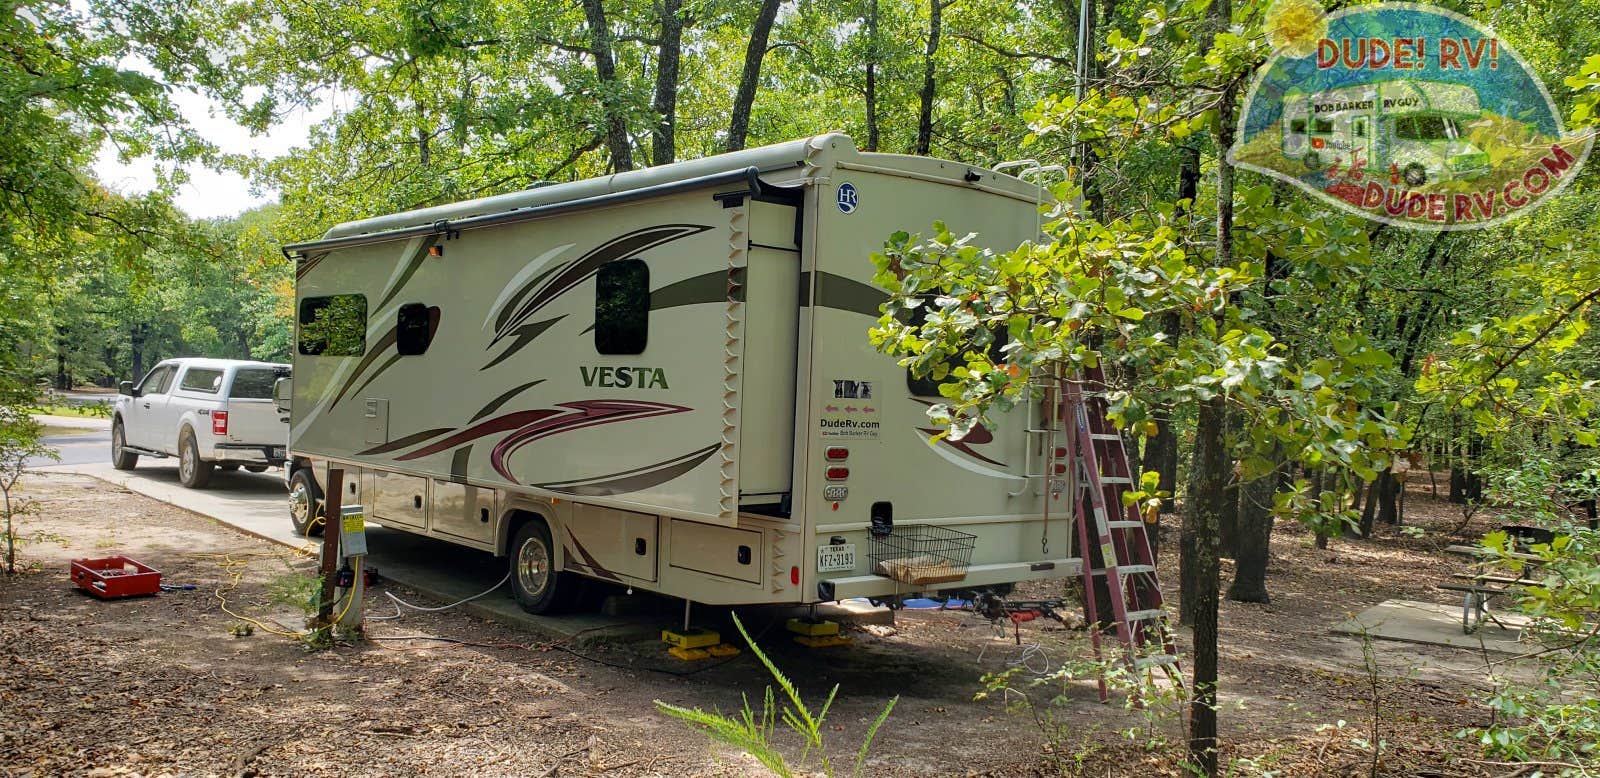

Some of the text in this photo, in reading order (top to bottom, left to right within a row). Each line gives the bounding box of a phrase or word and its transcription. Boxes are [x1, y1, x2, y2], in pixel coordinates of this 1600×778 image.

[839, 188, 857, 204] HR
[579, 366, 669, 390] VESTA
[820, 418, 880, 429] DudeRv.com
